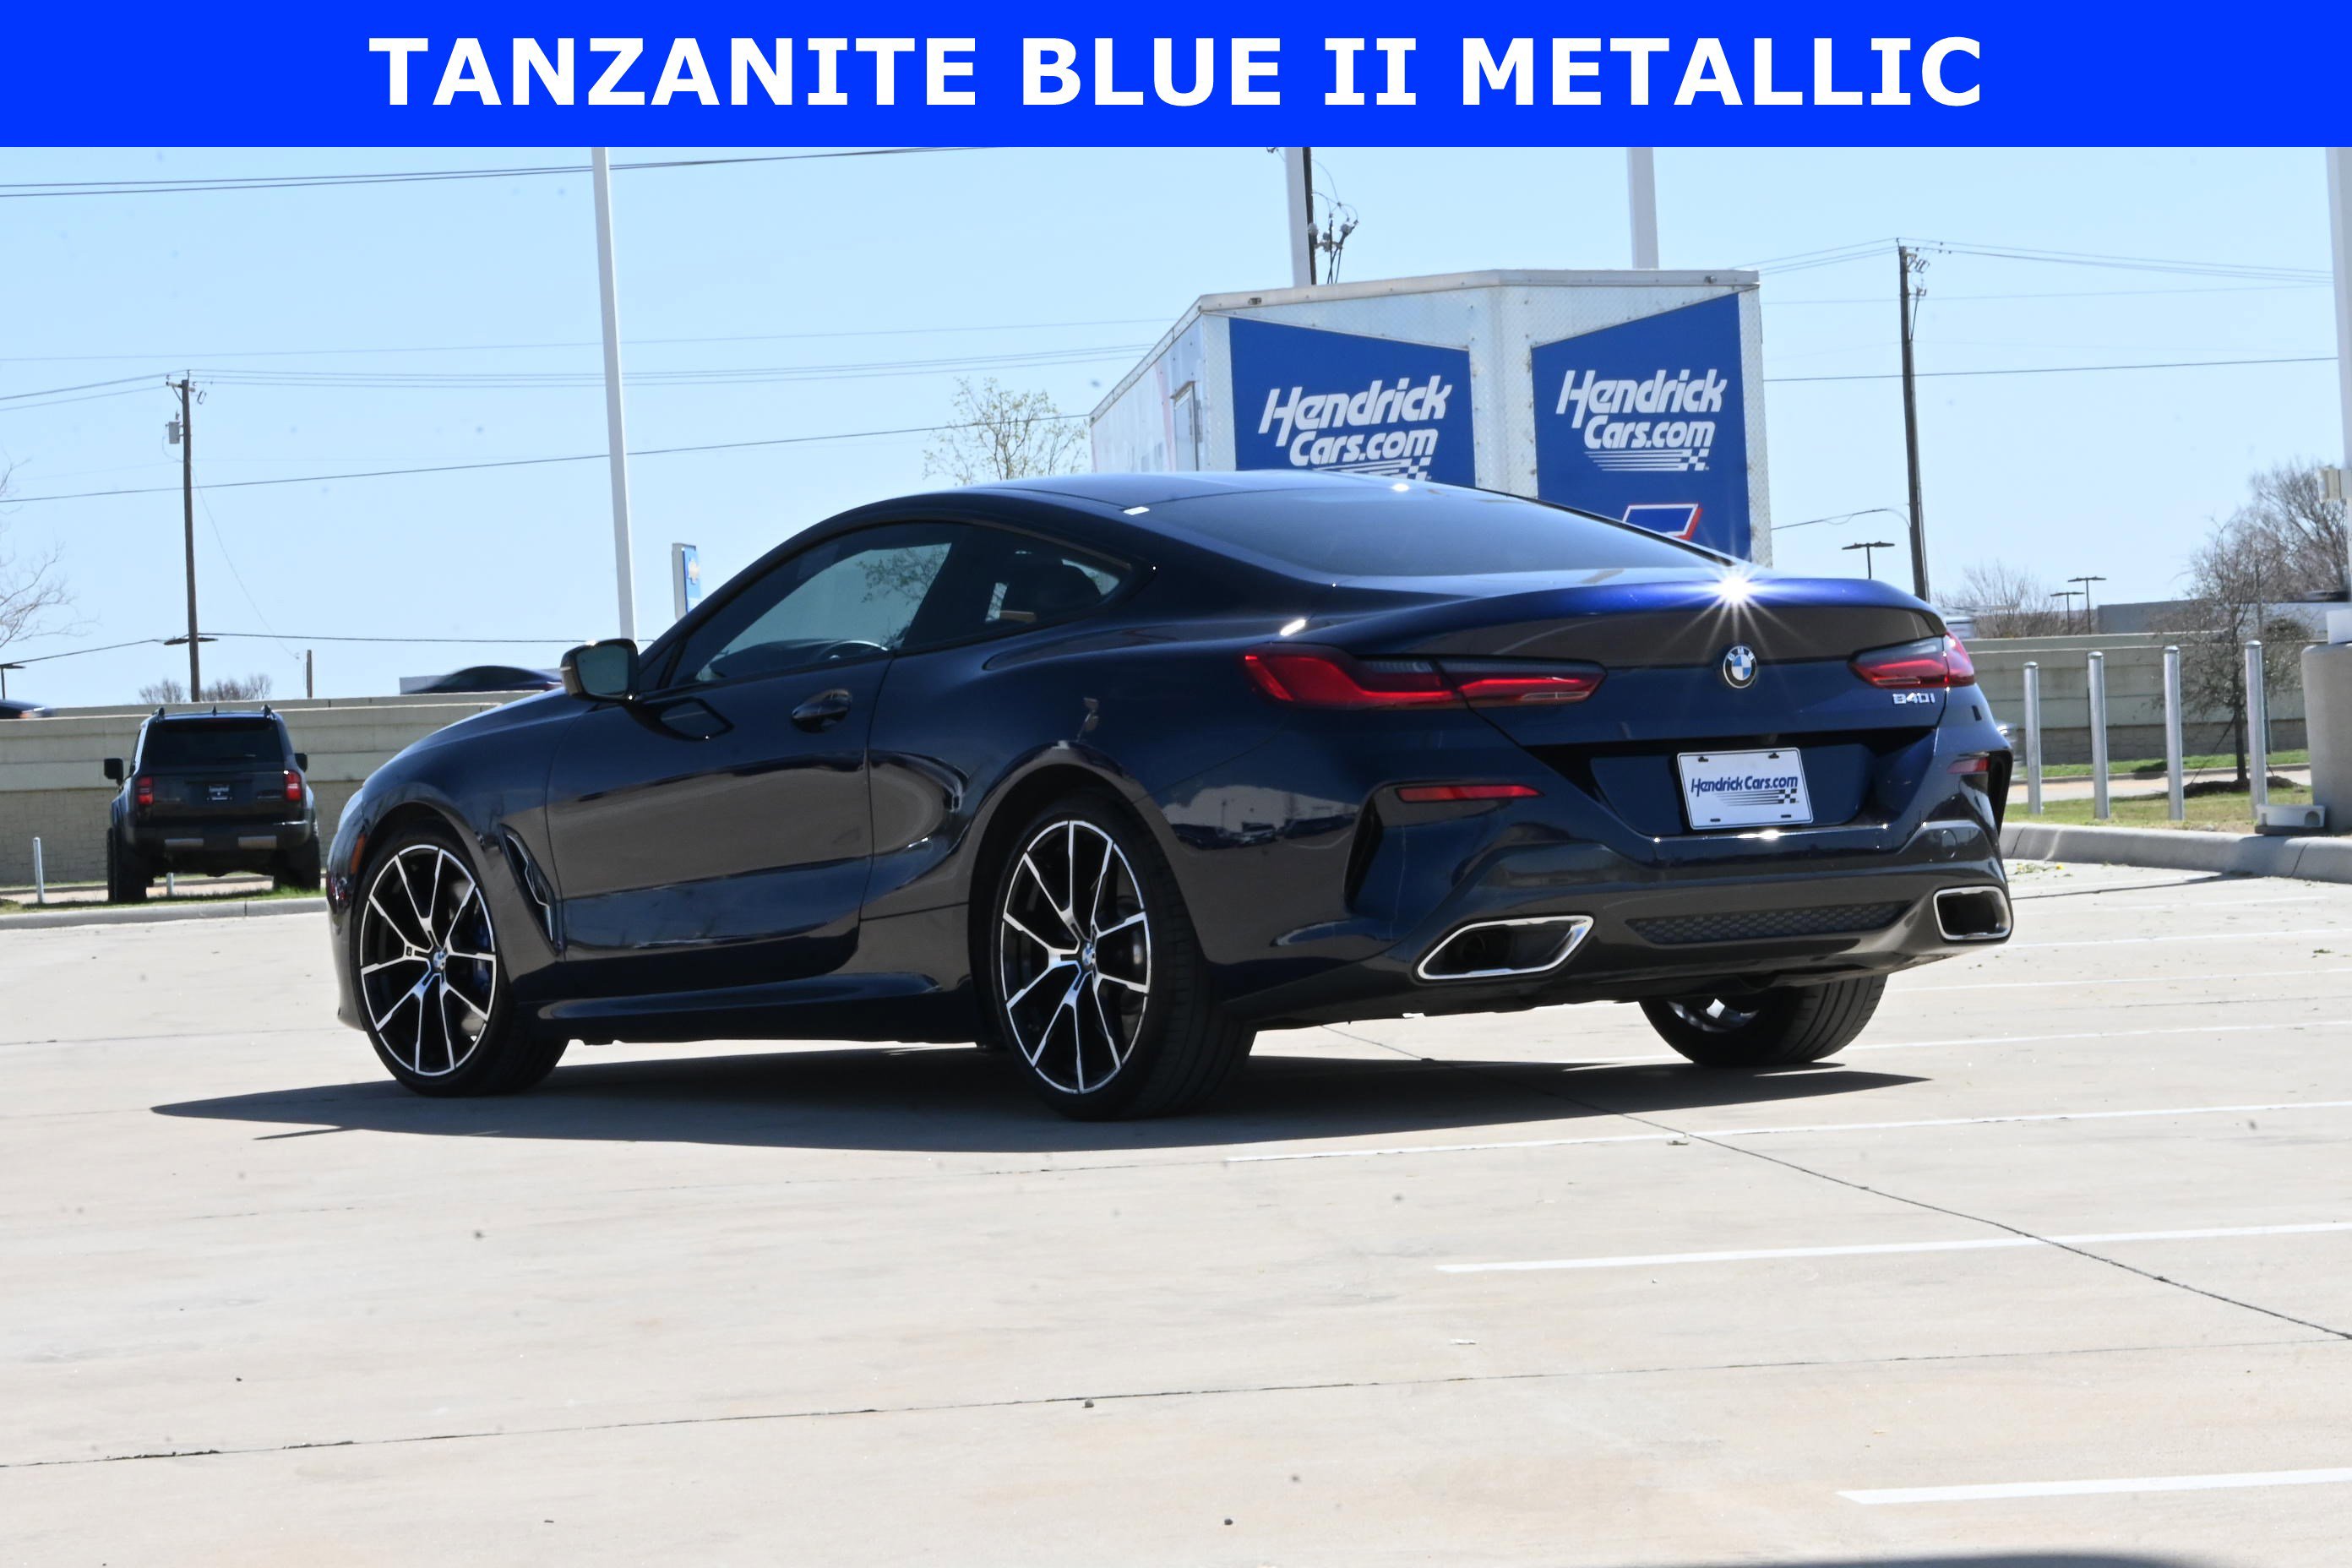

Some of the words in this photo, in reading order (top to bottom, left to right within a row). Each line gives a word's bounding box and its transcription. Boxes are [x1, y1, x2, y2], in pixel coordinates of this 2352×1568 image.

[1258, 375, 1453, 447] Hendrick
[1555, 368, 1728, 428] Hendrick
[1289, 428, 1439, 467] Cars.com
[1584, 414, 1717, 449] Cars.com
